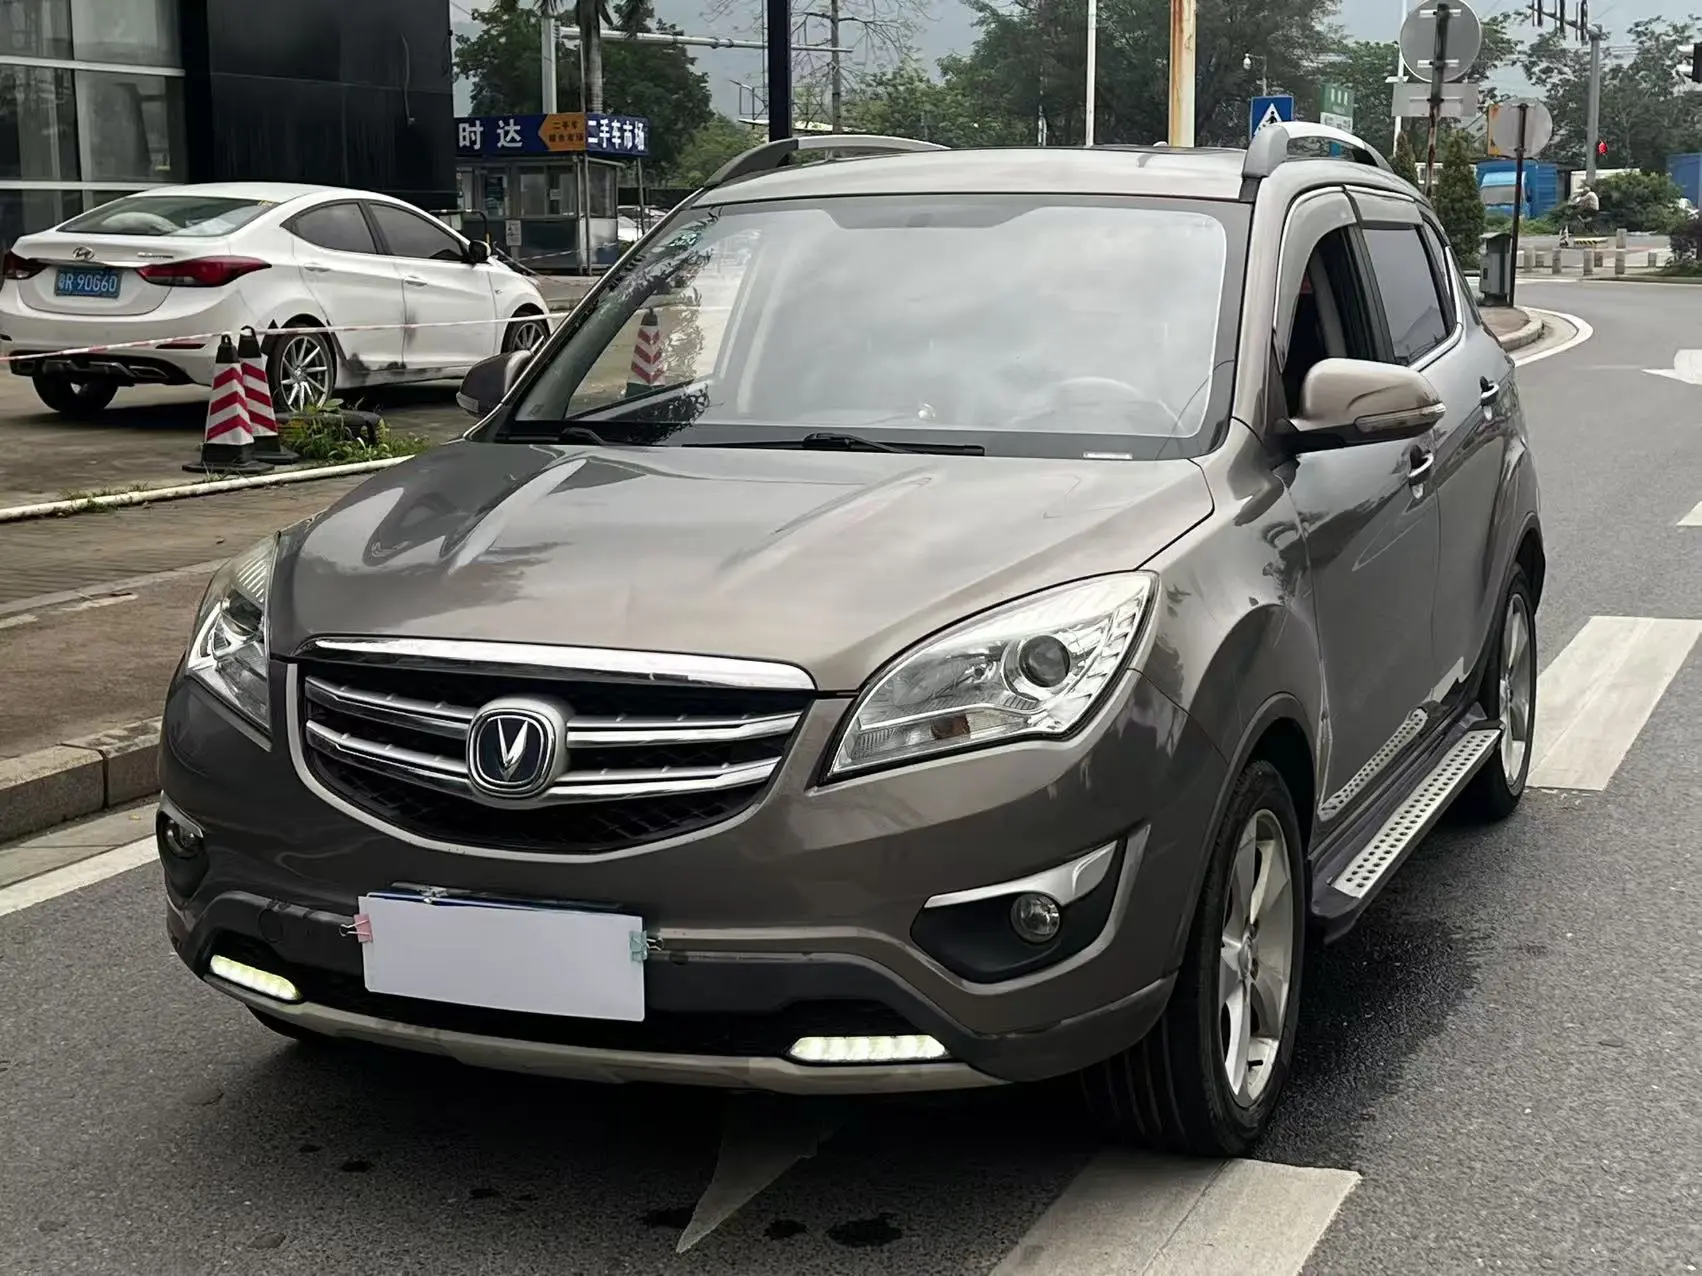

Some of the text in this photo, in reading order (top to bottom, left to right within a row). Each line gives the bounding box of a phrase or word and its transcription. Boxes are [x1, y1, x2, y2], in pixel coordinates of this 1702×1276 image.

[458, 119, 523, 150] 时达
[587, 119, 645, 150] 二手车市场
